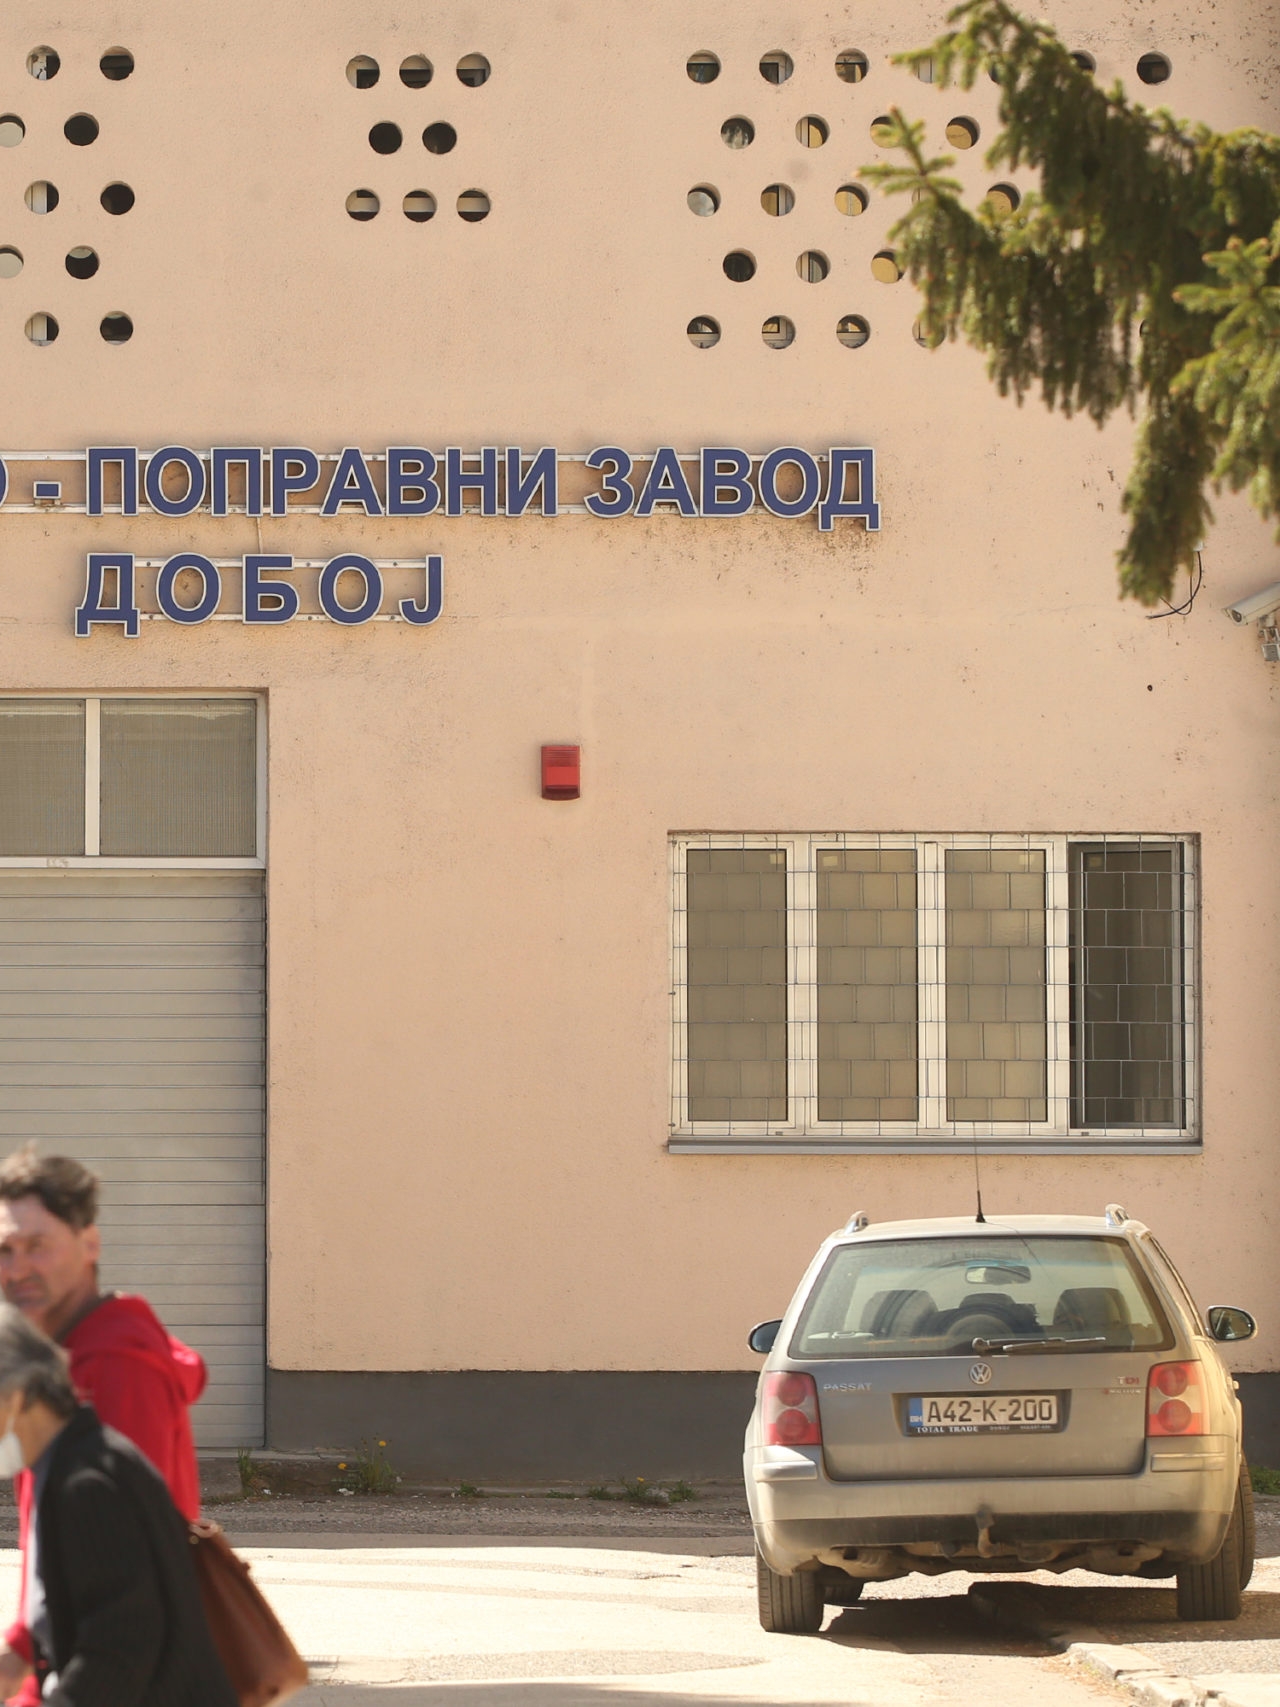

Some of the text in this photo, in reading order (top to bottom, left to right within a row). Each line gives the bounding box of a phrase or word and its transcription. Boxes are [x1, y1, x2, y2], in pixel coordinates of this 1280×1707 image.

[85, 445, 559, 518] ПОПРАВНИ
[583, 445, 881, 531] ЗАВОД
[75, 552, 444, 638] ДОБОЈ
[823, 1382, 872, 1392] PASSAT
[927, 1398, 1053, 1423] A42-K-200
[917, 1425, 944, 1433] TOTAL
[949, 1425, 979, 1433] TRADE
